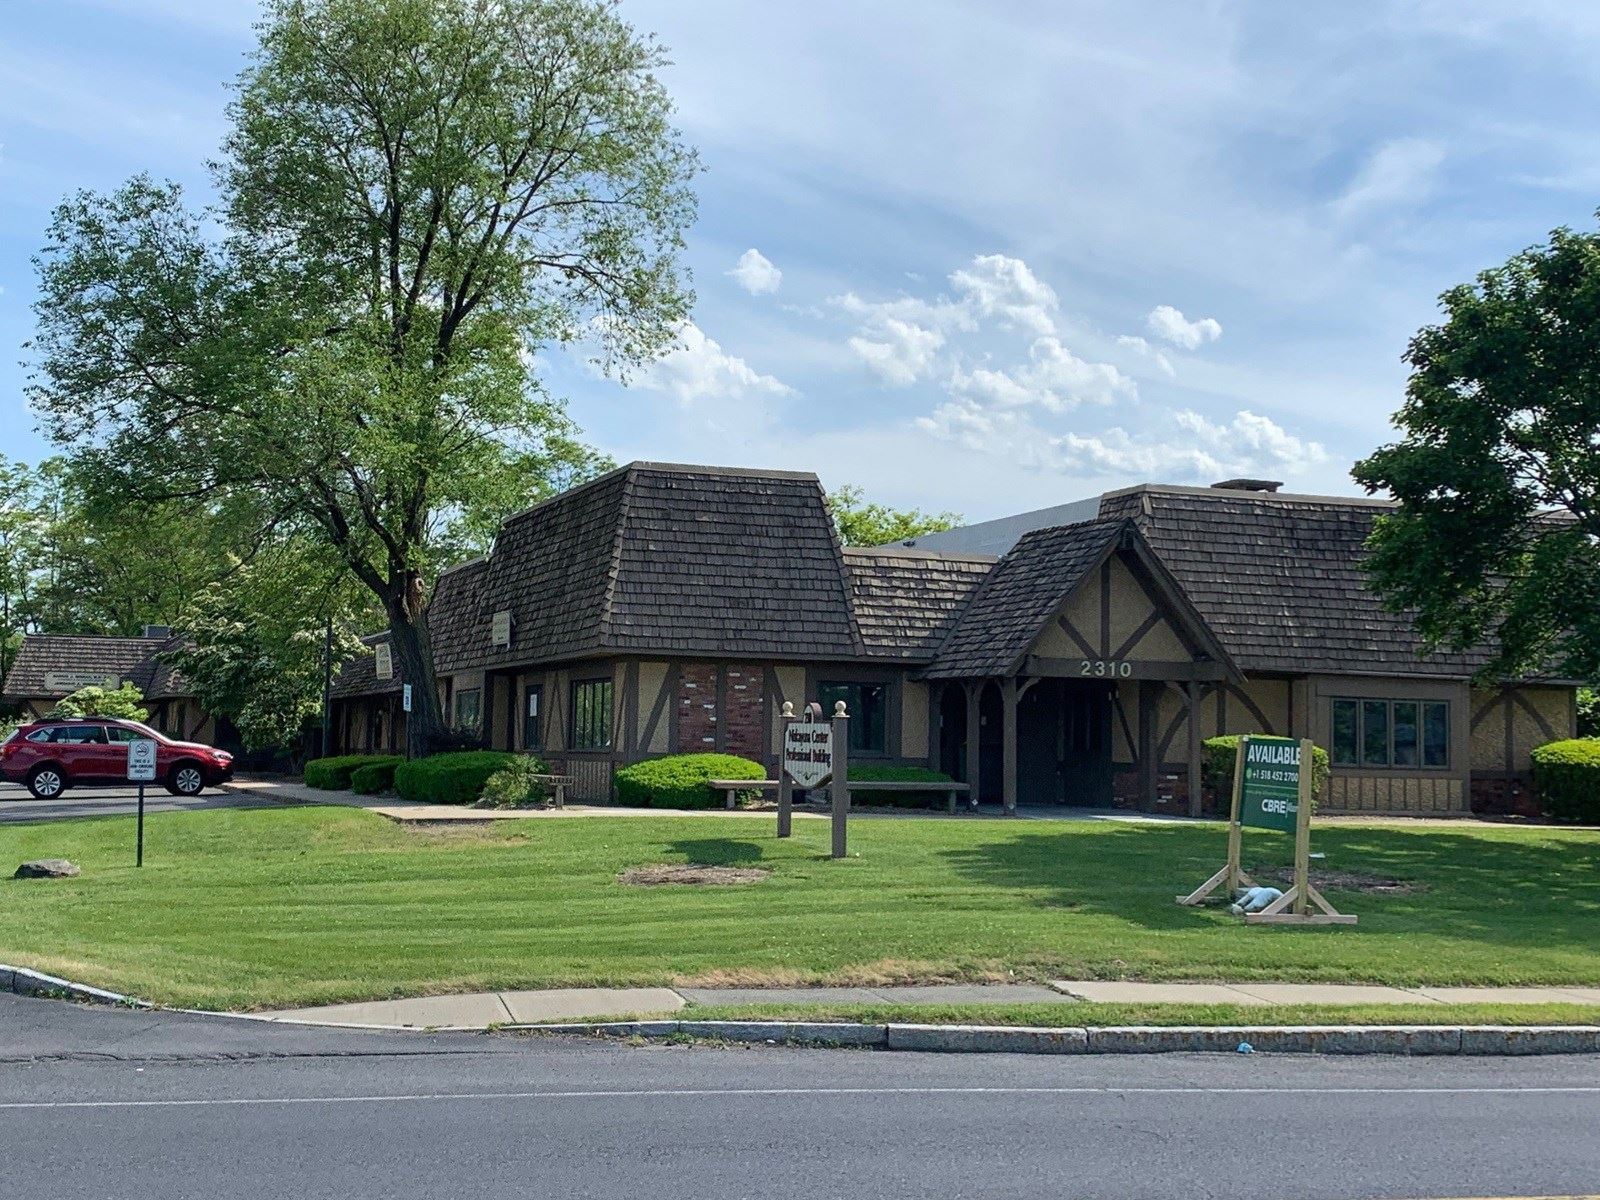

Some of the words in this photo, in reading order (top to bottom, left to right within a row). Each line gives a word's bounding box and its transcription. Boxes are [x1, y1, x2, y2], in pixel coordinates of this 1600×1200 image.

[1081, 660, 1131, 677] 2310
[1247, 744, 1301, 765] AVAILABLE
[1261, 769, 1271, 780] 518
[1272, 771, 1283, 781] 452
[1284, 772, 1299, 782] 2700
[1261, 798, 1287, 814] CBRE
